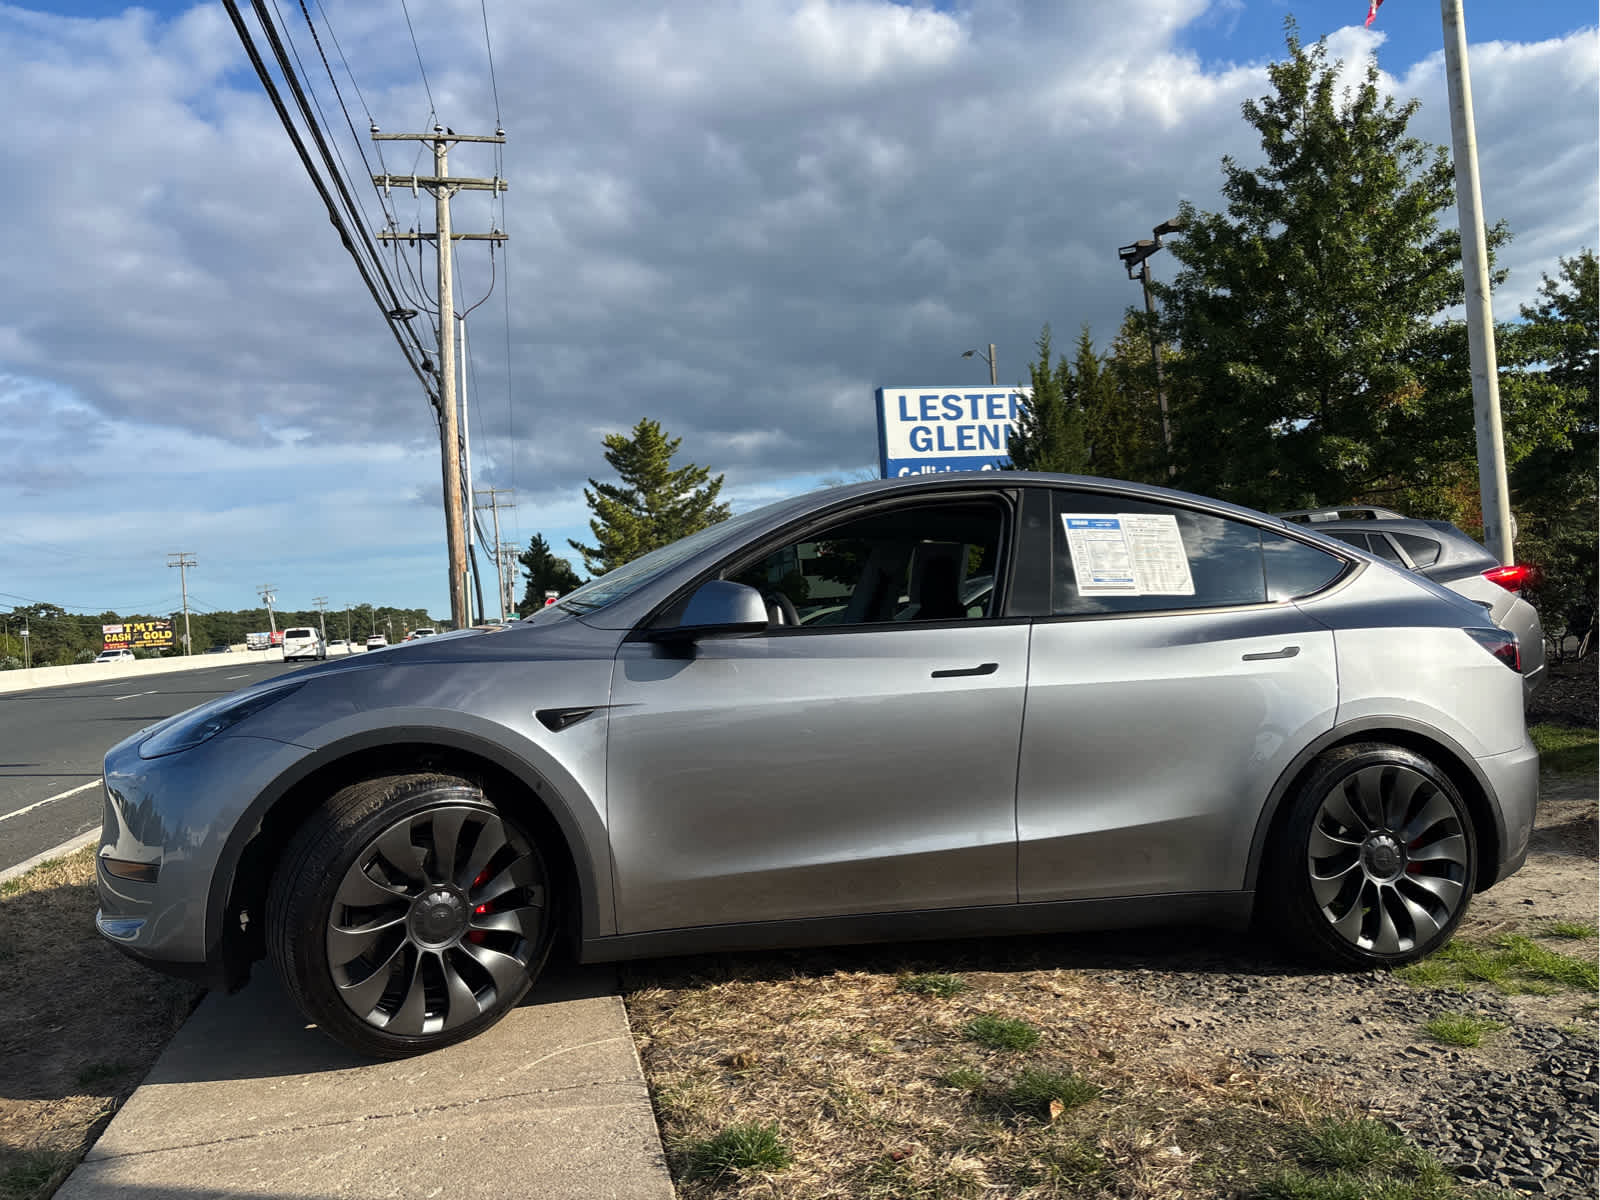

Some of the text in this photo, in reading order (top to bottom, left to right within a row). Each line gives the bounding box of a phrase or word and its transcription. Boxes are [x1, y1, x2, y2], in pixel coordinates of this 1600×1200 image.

[124, 622, 155, 632] TMT
[105, 633, 131, 642] CASH
[143, 630, 173, 639] GOLD
